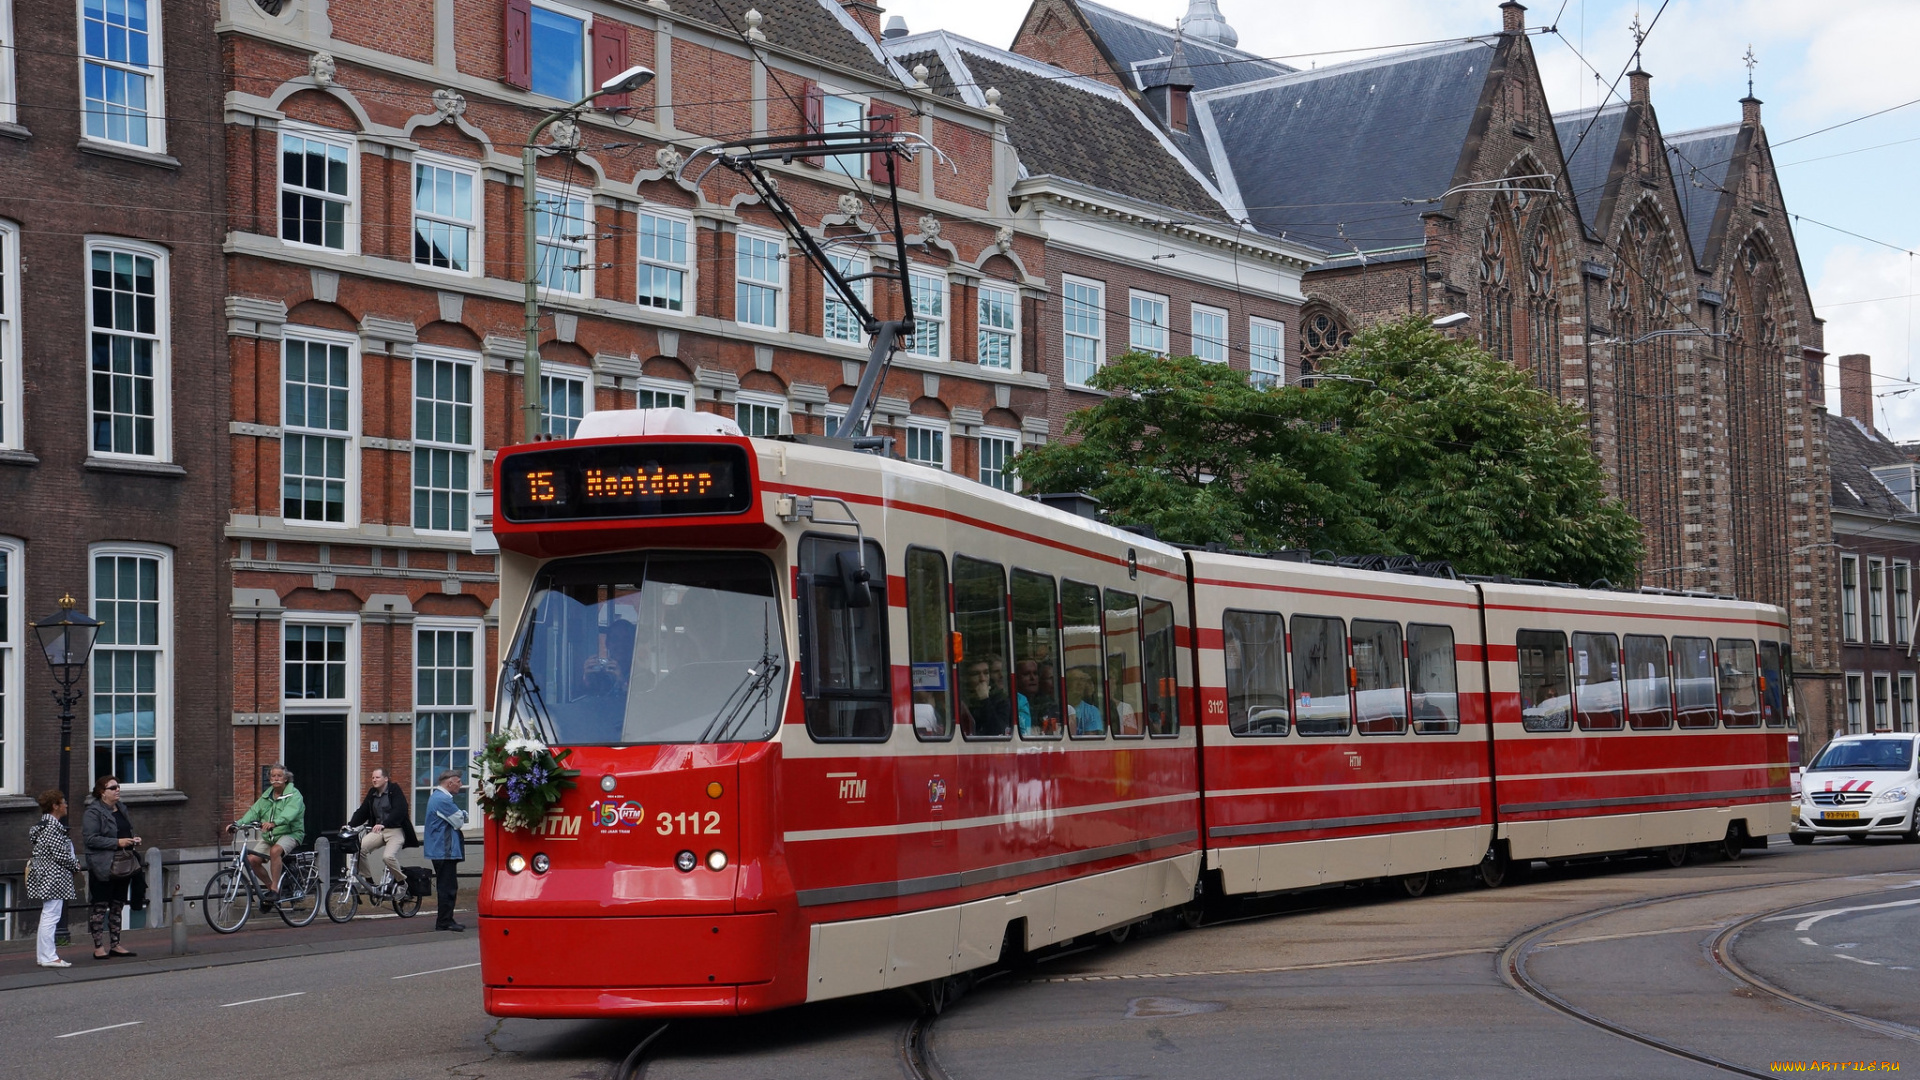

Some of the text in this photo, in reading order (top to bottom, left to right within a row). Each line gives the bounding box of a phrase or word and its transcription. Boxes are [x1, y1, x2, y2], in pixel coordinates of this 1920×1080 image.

[527, 467, 712, 501] 15 Nootdorp
[1208, 700, 1224, 714] 3112
[839, 779, 866, 799] HTM
[656, 811, 721, 836] 3112
